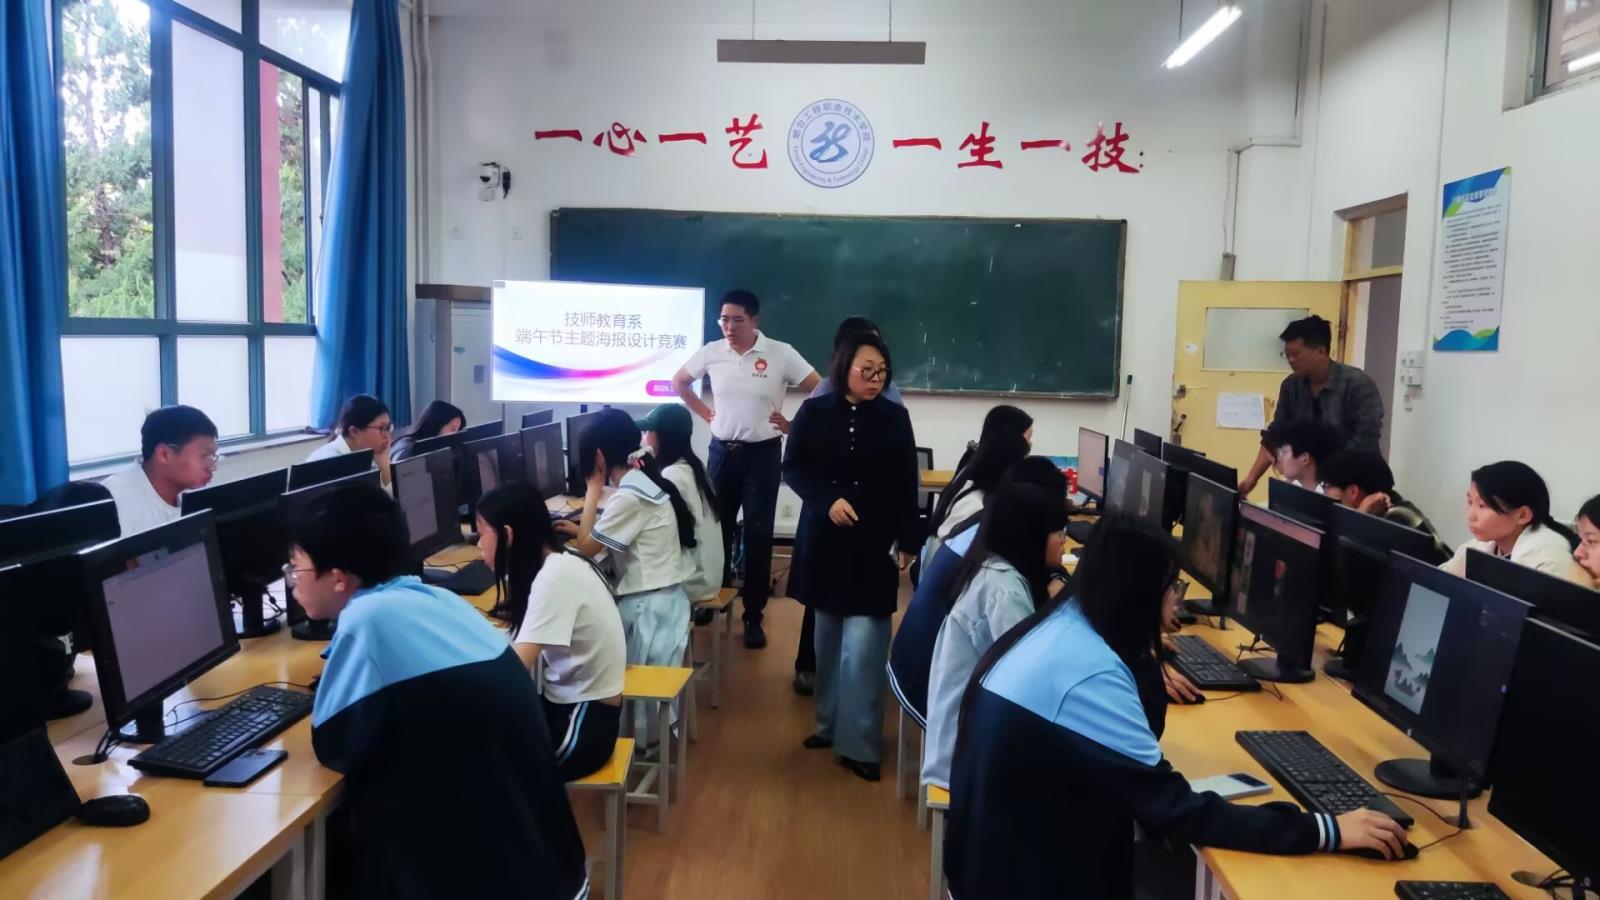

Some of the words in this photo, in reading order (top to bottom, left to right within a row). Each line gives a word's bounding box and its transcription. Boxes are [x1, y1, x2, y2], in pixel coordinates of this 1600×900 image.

[535, 113, 769, 171] 一心一艺
[564, 311, 643, 330] 技师教育系
[515, 328, 688, 350] 端午节主题海报设计竞赛
